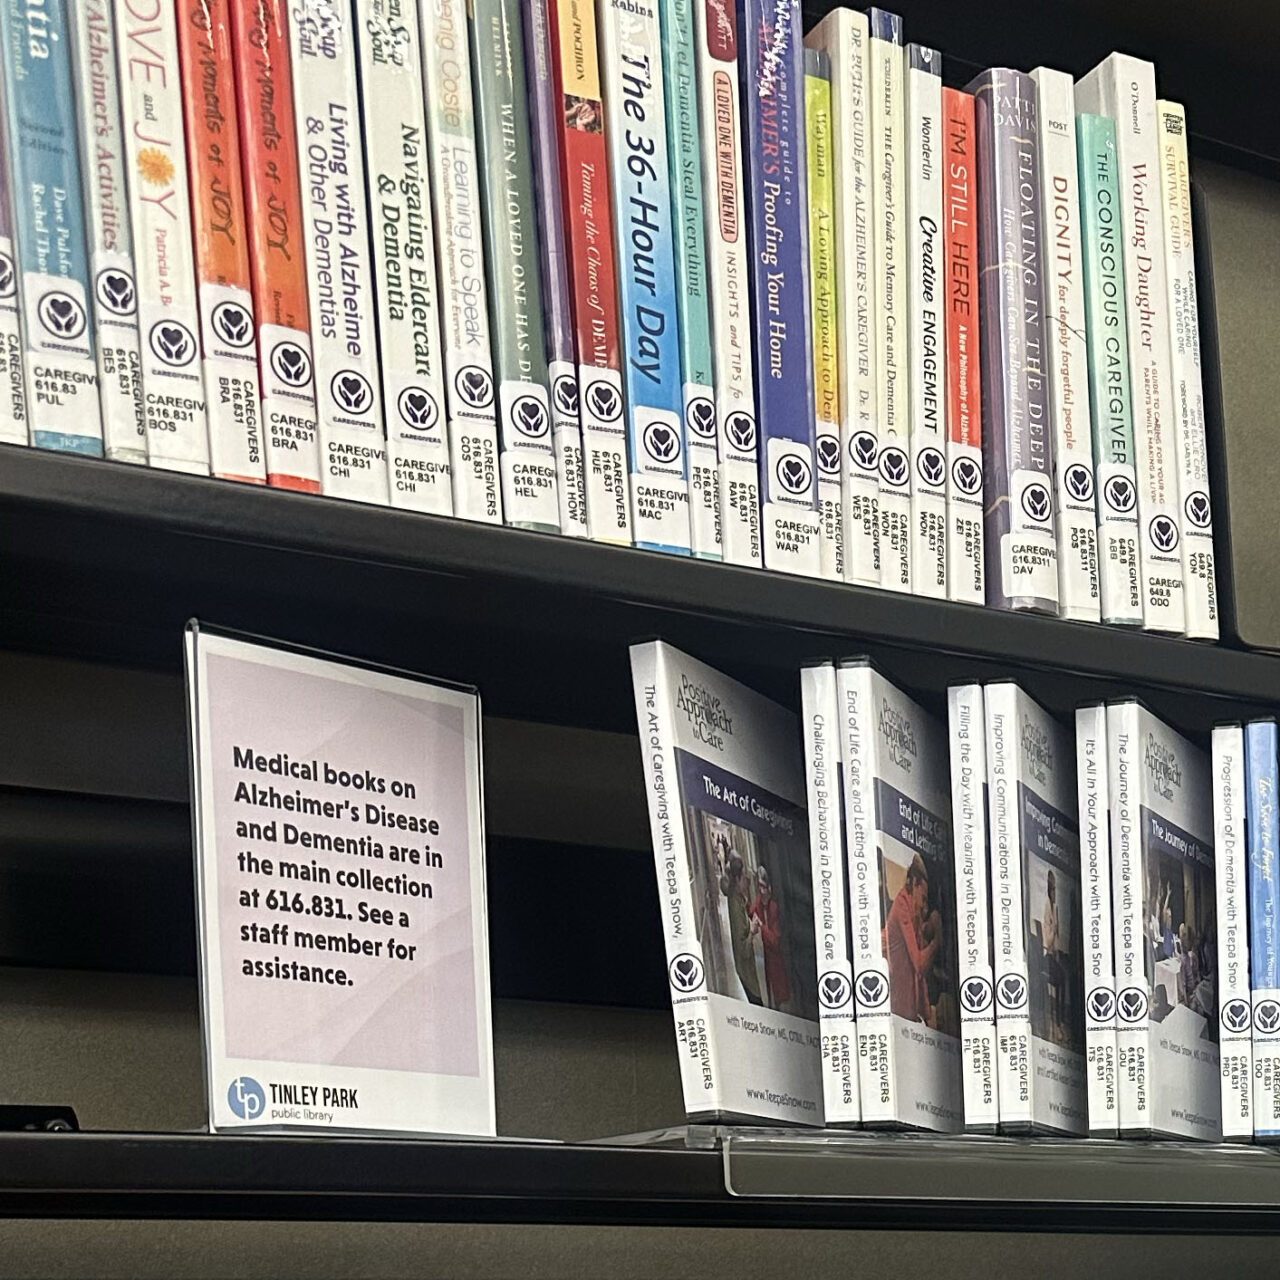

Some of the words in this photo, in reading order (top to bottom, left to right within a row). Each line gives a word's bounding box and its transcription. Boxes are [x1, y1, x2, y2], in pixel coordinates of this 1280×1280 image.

[621, 53, 653, 122] The
[306, 116, 324, 135] &
[328, 103, 348, 176] Living
[950, 118, 966, 153] I'M
[308, 144, 329, 211] Other
[1097, 153, 1109, 183] THE
[335, 184, 357, 236] with
[626, 131, 659, 296] 36-Hour
[760, 181, 785, 266] Proofing
[950, 163, 968, 233] STILL
[1018, 149, 1037, 286] FLOATING
[1132, 162, 1147, 251] Working
[1052, 175, 1072, 285] DIGNITY
[313, 218, 336, 338] Dementias
[918, 215, 938, 303] Creative
[952, 241, 970, 316] HERE
[1098, 189, 1119, 329] CONSCIOUS
[767, 271, 786, 315] Your
[1025, 300, 1039, 327] IN
[1136, 255, 1156, 352] Daughter
[630, 304, 665, 384] Day
[770, 318, 786, 379] Home
[1023, 338, 1041, 392] THE
[923, 309, 938, 433] ENGAGEMENT
[1105, 338, 1126, 465] CAREGIVER
[271, 426, 314, 442] 616.831
[272, 437, 298, 451] BRA
[1029, 405, 1045, 470] DEEP
[645, 685, 655, 708] The
[648, 714, 659, 732] Art
[651, 735, 660, 751] of
[233, 746, 318, 782] Medical
[324, 763, 385, 794] books
[392, 777, 416, 799] on
[652, 754, 669, 821] Caregiving
[235, 783, 359, 822] Alzheimer's
[366, 805, 440, 836] Disease
[236, 820, 277, 844] and
[283, 826, 383, 859] Dementia
[389, 843, 420, 863] are
[425, 846, 443, 869] in
[660, 825, 673, 853] with
[237, 852, 273, 877] the
[279, 859, 330, 884] main
[336, 866, 433, 899] collection
[665, 855, 677, 895] Teepa
[239, 889, 261, 908] at
[265, 890, 353, 922] 616.831.
[358, 902, 393, 925] See
[399, 912, 409, 928] a
[670, 899, 682, 939] Snow,
[241, 923, 288, 948] staff
[294, 930, 382, 957] member
[387, 938, 417, 961] for
[242, 957, 354, 987] assistance.
[677, 1021, 687, 1043] ART
[687, 1019, 698, 1058] 616.831
[695, 1018, 713, 1090] CAREGIVERS
[270, 1084, 318, 1106] TINLEY
[323, 1088, 359, 1109] PARK
[272, 1109, 300, 1121] public
[303, 1109, 333, 1123] library
